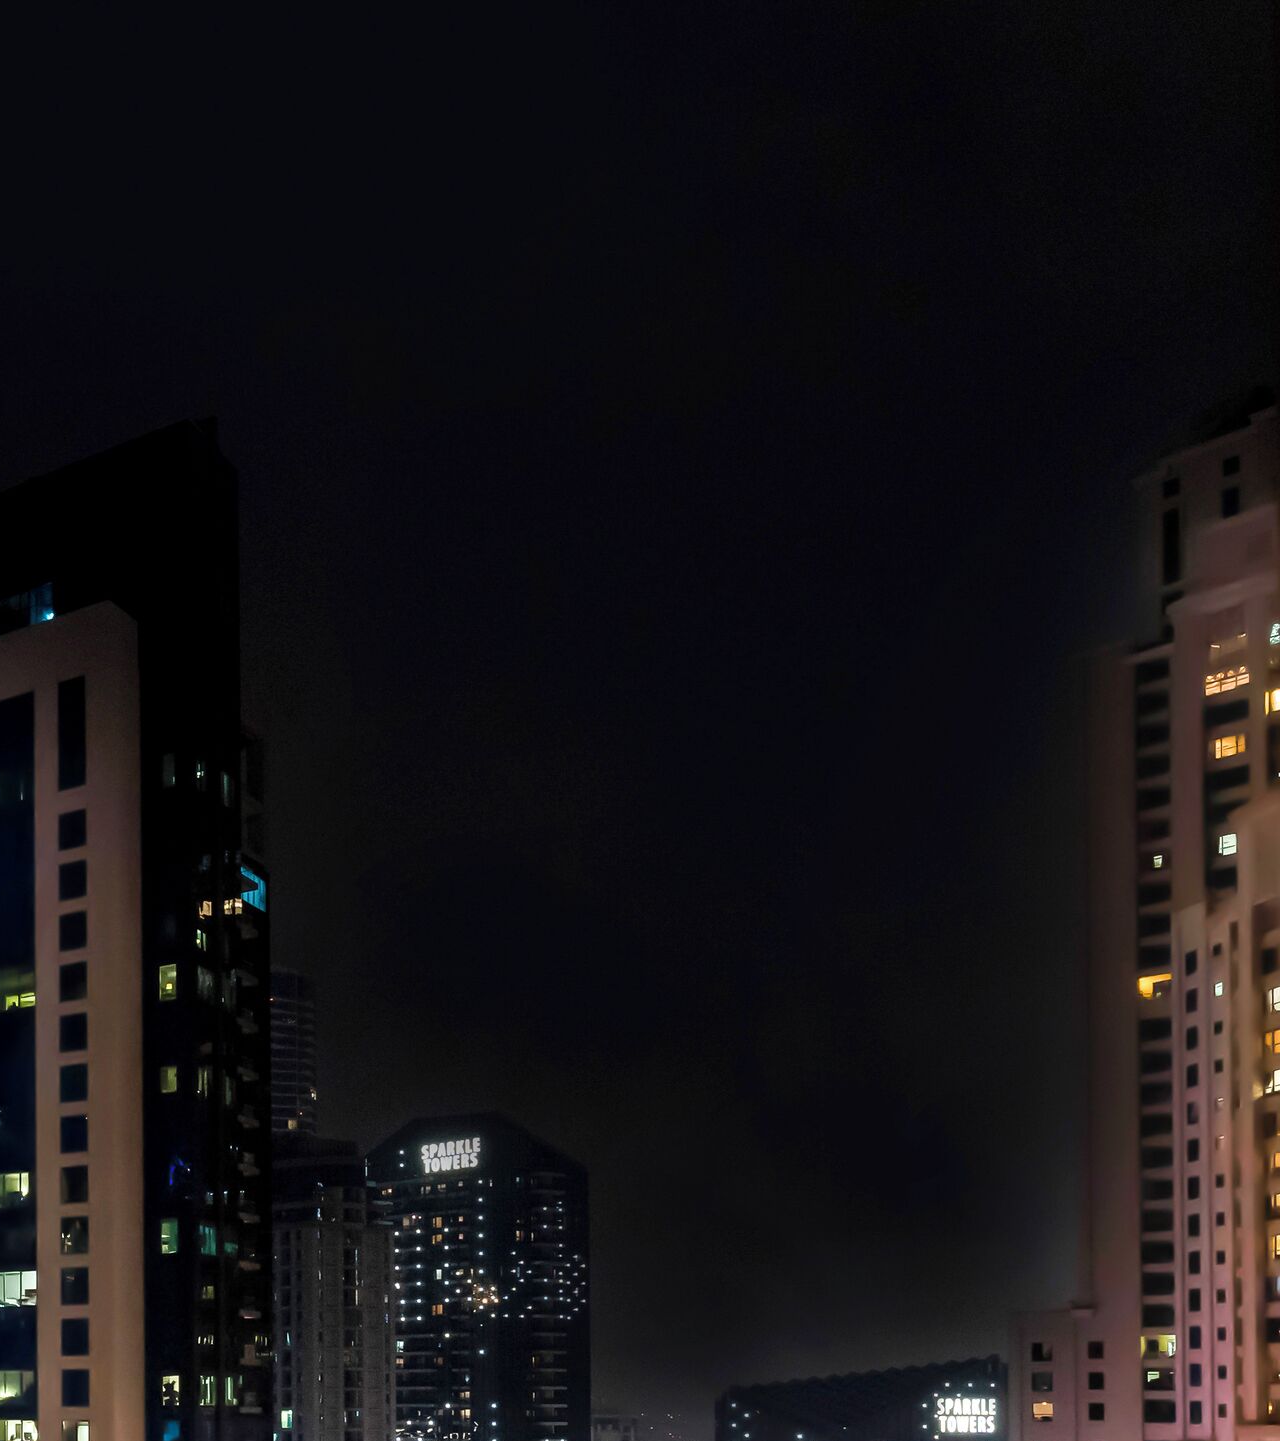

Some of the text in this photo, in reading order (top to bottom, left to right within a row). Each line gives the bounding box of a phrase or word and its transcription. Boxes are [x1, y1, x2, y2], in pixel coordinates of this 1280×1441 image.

[421, 1138, 481, 1160] SPARKLE
[423, 1153, 479, 1174] TOWERS
[936, 1398, 997, 1416] SPARKLE
[938, 1415, 996, 1433] TOWERS
